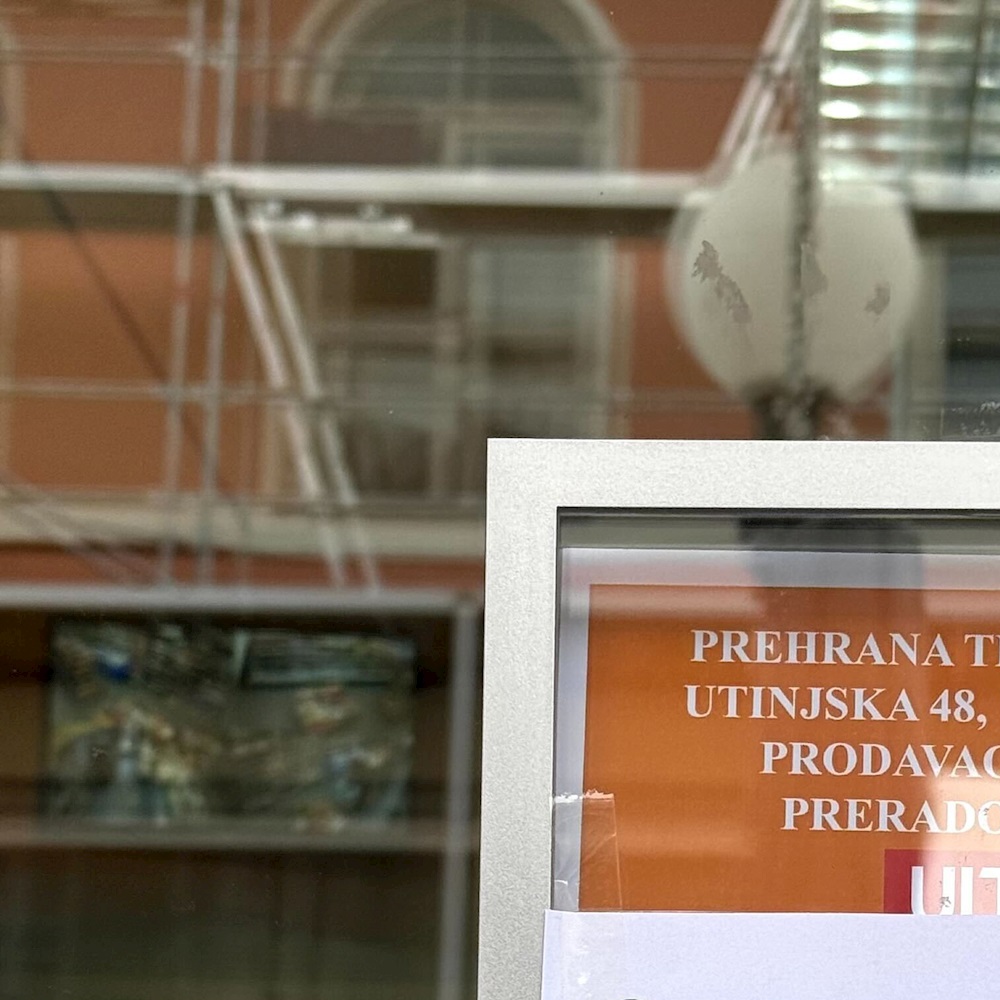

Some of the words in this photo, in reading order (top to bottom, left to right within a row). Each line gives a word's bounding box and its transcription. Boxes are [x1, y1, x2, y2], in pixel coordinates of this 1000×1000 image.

[690, 629, 955, 667] PREHRANA
[684, 684, 920, 721] UTINJSKA
[929, 688, 988, 731] 48,
